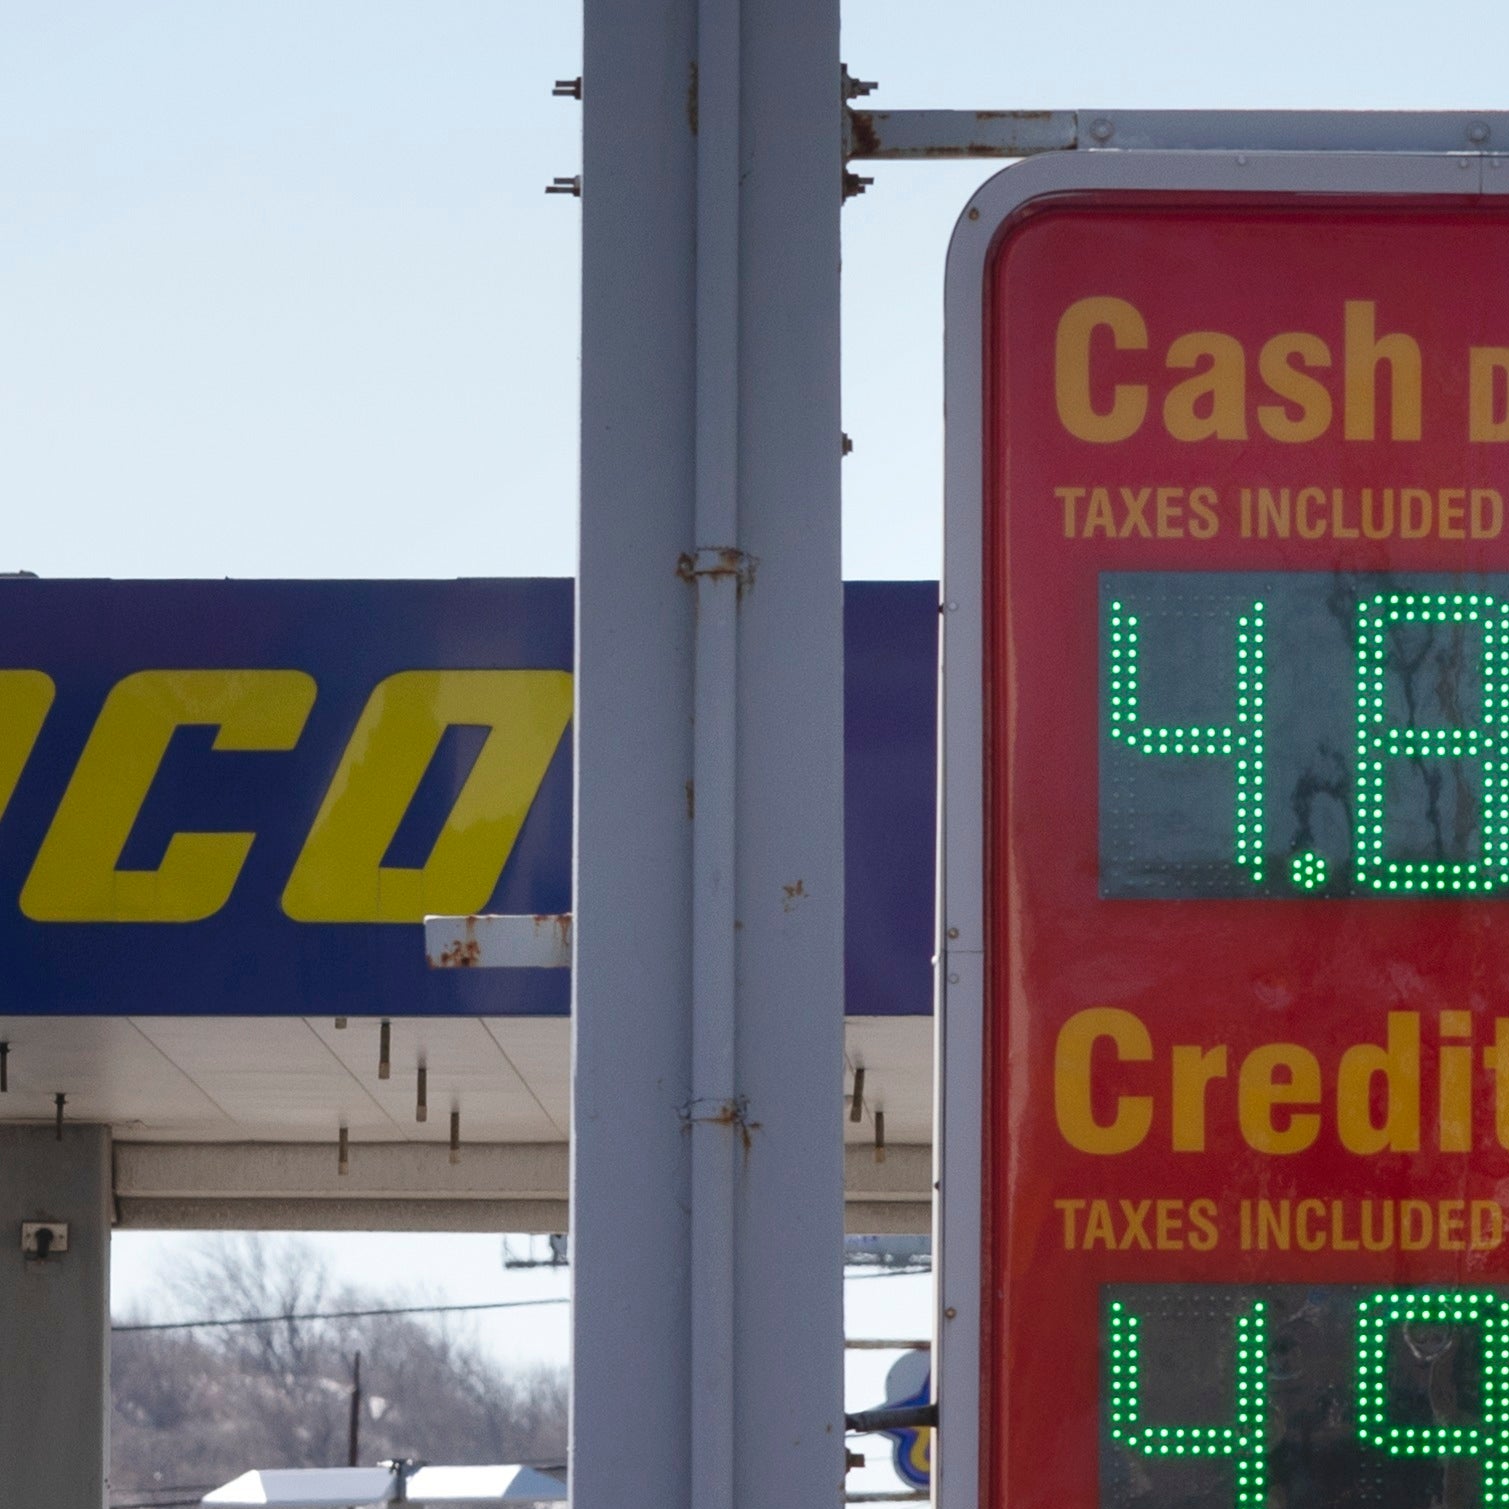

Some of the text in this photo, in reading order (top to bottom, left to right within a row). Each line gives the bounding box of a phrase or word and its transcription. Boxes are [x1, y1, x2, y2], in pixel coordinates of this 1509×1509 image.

[1055, 296, 1423, 444] Cash
[1055, 487, 1504, 540] TAXES INCLUDED
[0, 669, 574, 923] CO
[1054, 1199, 1504, 1252] TAXES INCLUDED
